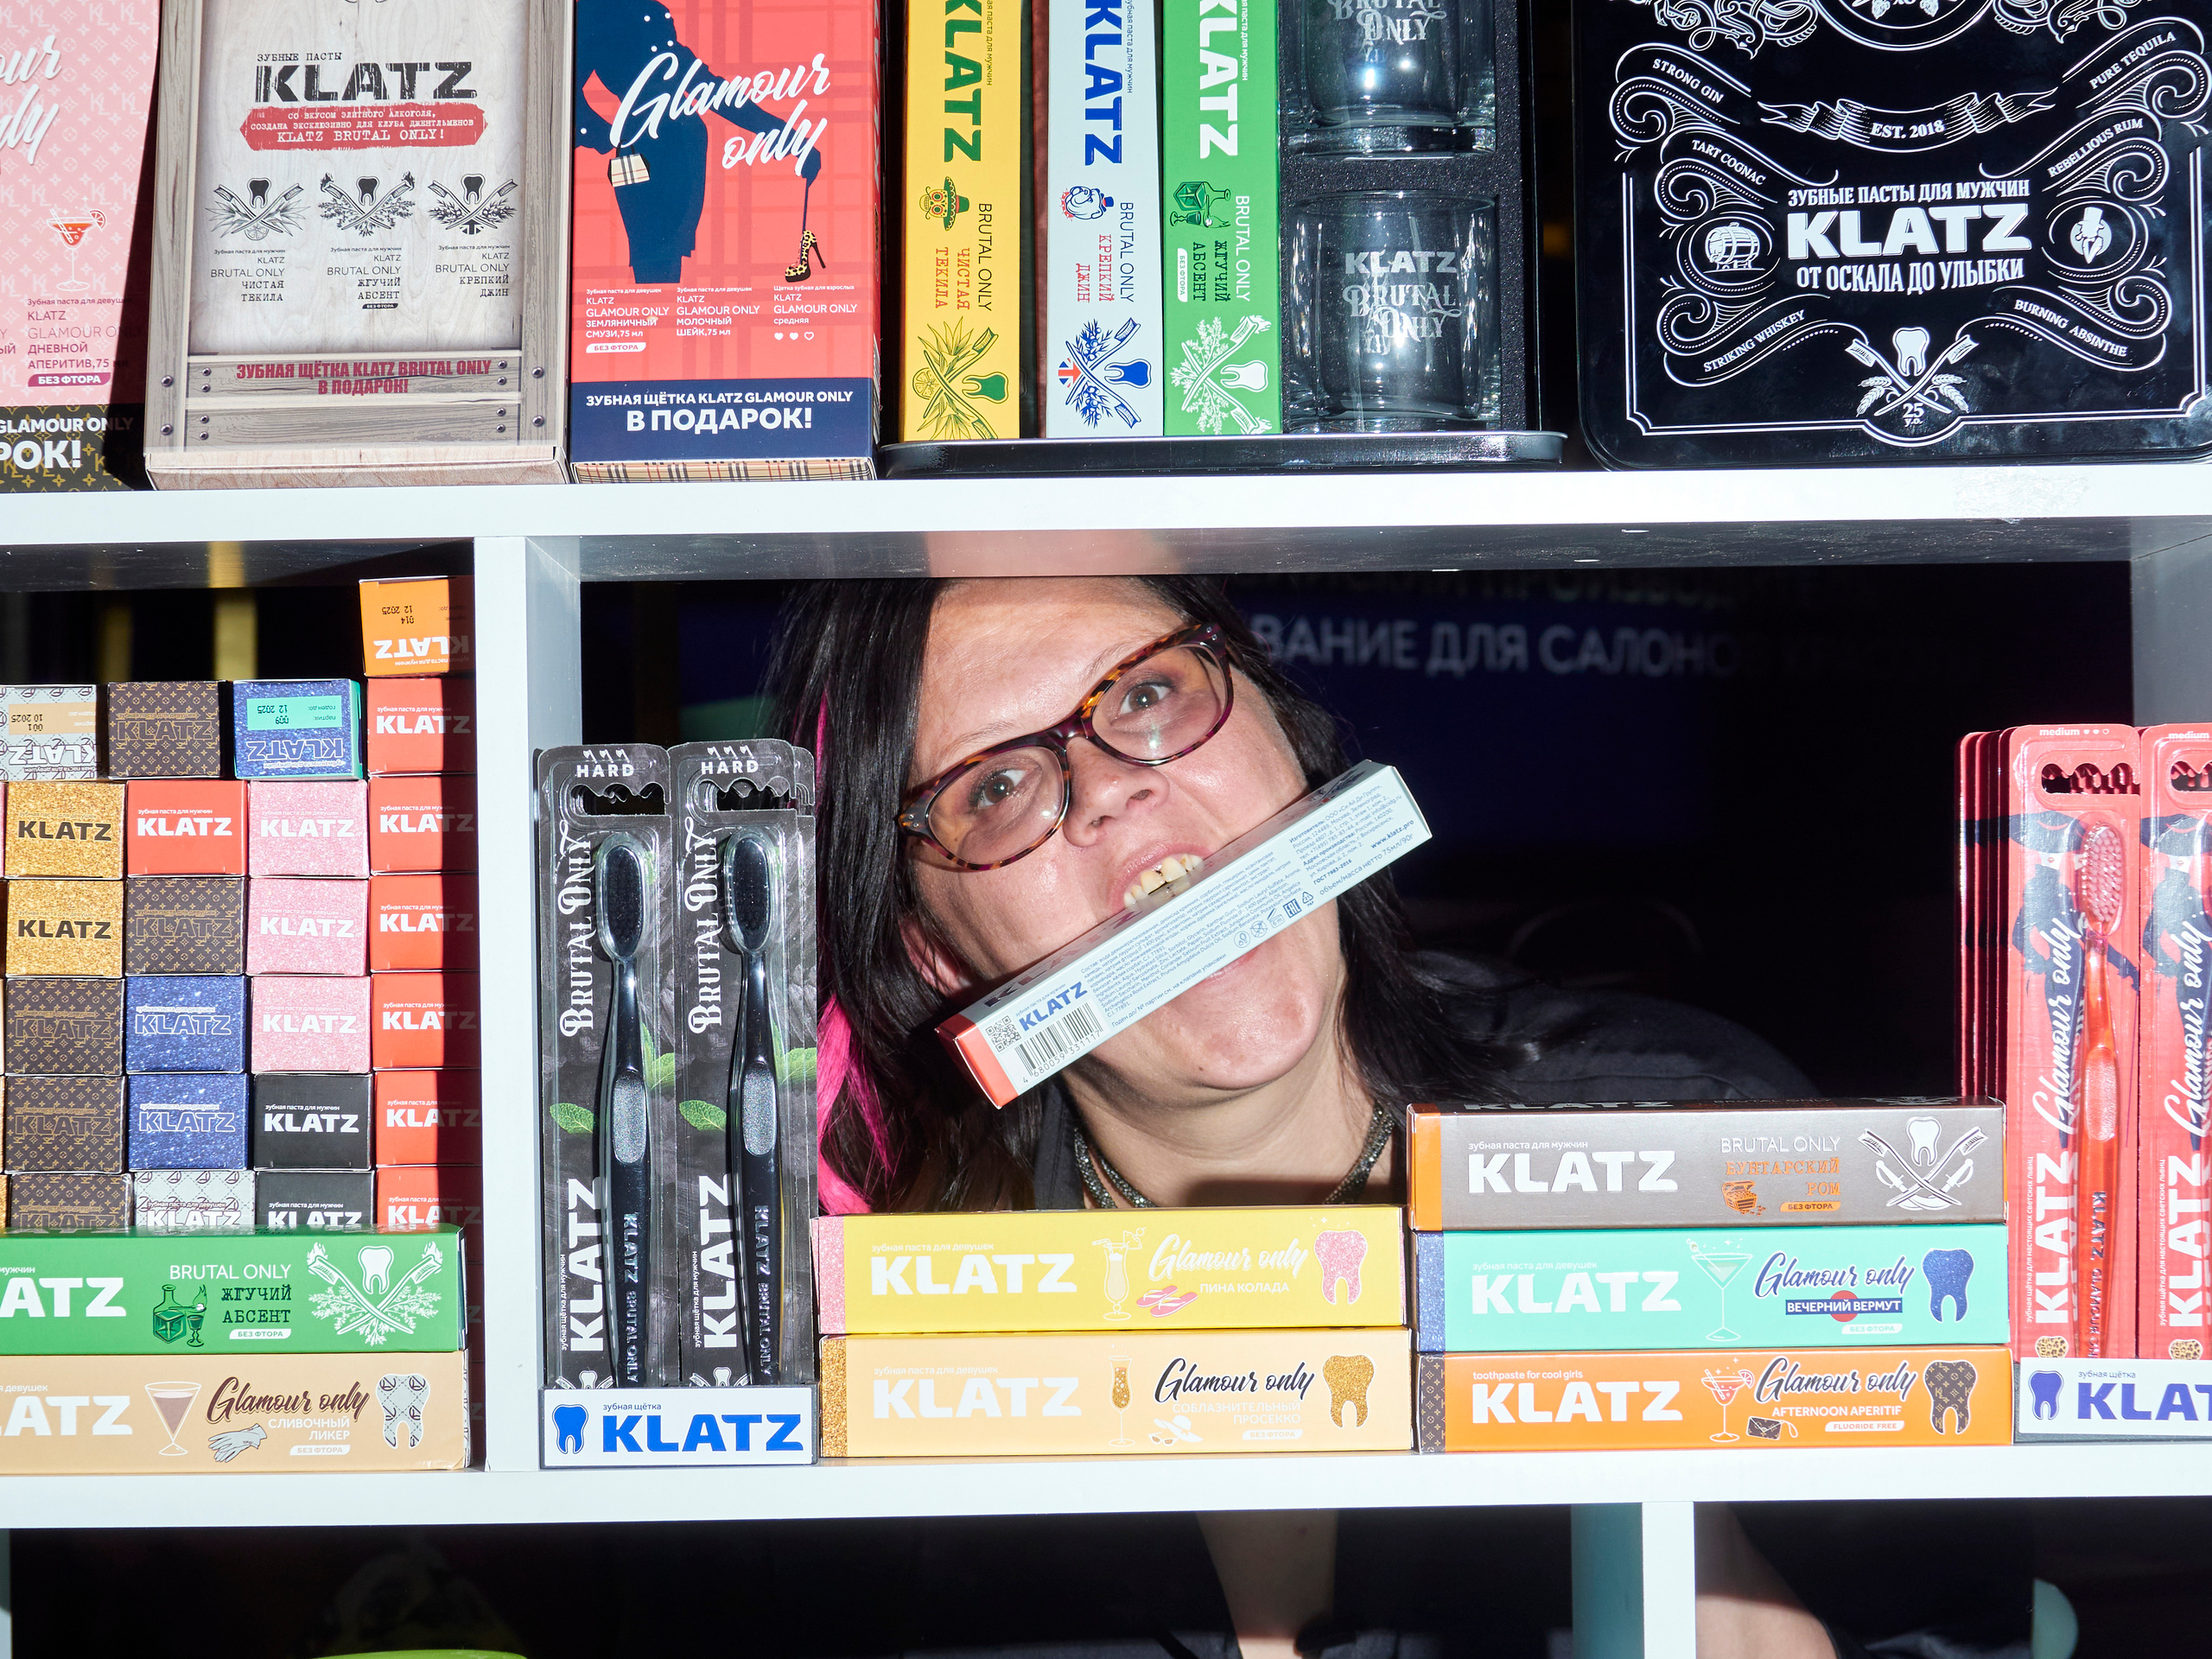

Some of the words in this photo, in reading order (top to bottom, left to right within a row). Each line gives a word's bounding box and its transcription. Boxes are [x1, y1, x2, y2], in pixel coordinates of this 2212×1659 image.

[257, 53, 300, 62] ЗУБНЫЕ
[306, 52, 342, 61] ПАСТЫ
[2088, 62, 2123, 90] PURE
[2120, 31, 2177, 67] TEQUILA
[255, 62, 478, 102] KLATZ
[1085, 0, 1122, 166] KLATZ
[1652, 58, 1700, 90] STRONG
[1700, 85, 1725, 104] GIN
[609, 52, 831, 149] Glamour
[341, 111, 385, 119] ЭЛИТНОГО
[389, 110, 436, 119] АЛКОГОЛЯ,
[276, 131, 324, 143] KLATZ
[334, 130, 391, 142] BRUTAL
[400, 129, 445, 141] ONLY!
[721, 99, 828, 177] only
[1871, 123, 1907, 139] EST.
[1909, 119, 1945, 138] 2018
[2047, 130, 2115, 178] REBELLIOUS
[2113, 118, 2144, 135] RUM
[1691, 139, 1723, 161] TART
[1719, 153, 1766, 187] COGNAC
[1788, 187, 1854, 207] ЗУБНЫЕ
[1858, 184, 1916, 205] ПАСТЫ
[1918, 182, 1952, 203] ДЛЯ
[1955, 179, 2031, 200] МУЖЧИН
[978, 203, 992, 264] BRUTAL
[1235, 195, 1249, 256] BRUTAL
[1787, 203, 2032, 260] KLATZ
[1099, 234, 1115, 302] КРЕПКИЙ
[1193, 242, 1206, 301] АБСЕНТ
[1215, 240, 1230, 302] ЖГУЧИЙ
[1345, 251, 1458, 275] KLATZ
[242, 280, 285, 289] ЧИСТАЯ
[357, 276, 401, 287] ЖГУЧИЙ
[459, 273, 510, 285] КРЕПКИЙ
[936, 247, 948, 308] ТЕКИЛА
[957, 247, 969, 309] ЧИСТАЯ
[1076, 264, 1090, 303] ДЖИН
[1236, 260, 1250, 302] ONLY
[1796, 265, 1822, 289] ОТ
[1825, 263, 1905, 295] ОСКАЛА
[1907, 262, 1936, 296] ДО
[1940, 258, 2024, 291] УЛЫБКИ
[241, 293, 284, 302] ТЕКИЛА
[358, 289, 401, 300] АБСЕНТ
[480, 288, 510, 298] ДЖИН
[978, 268, 992, 311] ONLY
[1342, 283, 1457, 317] BRUTAL
[28, 310, 67, 321] KLATZ
[586, 307, 639, 317] GLAMOUR
[641, 306, 670, 316] ONLY
[586, 316, 658, 327] ЗЕМЛЯНИЧНЫЙ
[677, 316, 732, 326] МОЛОЧНЫЙ
[773, 317, 809, 326] средняя
[28, 326, 103, 340] GLAMOUR
[677, 327, 717, 337] ШЕЙК,75
[1375, 304, 1463, 342] ONLY
[2013, 299, 2069, 329] BURNING
[2069, 325, 2128, 357] ABSINTHE
[586, 329, 630, 339] СМУЗИ,75
[1703, 338, 1756, 373] STRIKING
[1753, 309, 1806, 343] WHISKEY
[27, 341, 88, 355] ДНЕВНОЙ
[28, 359, 110, 370] АПЕРИТИВ,75
[237, 363, 295, 379] ЗУБНАЯ
[298, 360, 350, 379] ЩЁТКА
[353, 362, 396, 378] KLATZ
[397, 361, 454, 377] BRUTAL
[456, 360, 493, 376] ONLY
[38, 376, 60, 385] БЕЗ
[61, 375, 101, 385] ФТОРА
[318, 380, 327, 396] В
[332, 378, 410, 397] ПОДАРОК!
[586, 394, 642, 406] ЗУБНАЯ
[644, 391, 696, 407] ЩЁТКА
[698, 392, 743, 404] KLATZ
[745, 391, 815, 404] GLAMOUR
[817, 391, 854, 403] ONLY
[1902, 403, 1925, 418] 25
[86, 417, 134, 431] ONLY
[626, 410, 645, 432] В
[651, 408, 813, 435] ПОДАРОК!
[373, 635, 469, 659] KLATZ
[1427, 622, 1528, 677] ДЛЯ
[1538, 622, 1763, 679] САЛОНО
[11, 714, 32, 723] 2025
[34, 714, 43, 722] 10
[377, 715, 471, 734] KLATZ
[2039, 728, 2081, 736] medium
[246, 738, 344, 761] KLATZ
[576, 764, 635, 778] HARD
[18, 820, 112, 841] KLATZ
[137, 817, 232, 836] KLATZ
[260, 818, 354, 838] KLATZ
[1370, 819, 1414, 849] www.klatz.pro
[557, 820, 593, 915] ONLY
[2040, 918, 2082, 985] only
[559, 916, 596, 1037] BRUTAL
[1019, 981, 1088, 1032] KLATZ
[135, 1014, 232, 1035] KLATZ
[2033, 995, 2075, 1135] Glamour
[264, 1113, 359, 1134] KLATZ
[1720, 1138, 1789, 1154] BRUTAL
[1794, 1136, 1840, 1153] ONLY
[1468, 1151, 1679, 1193] KLATZ
[1725, 1157, 1840, 1177] БУНТАРСКИЙ
[1806, 1181, 1840, 1198] РОМ
[2036, 1151, 2070, 1325] KLATZ
[169, 1264, 240, 1281] BRUTAL
[244, 1263, 292, 1280] ONLY
[568, 1178, 604, 1351] KLATZ
[871, 1253, 1077, 1296] KLATZ
[1755, 1253, 1857, 1297] Glamour
[1865, 1255, 1915, 1294] only
[221, 1283, 292, 1302] ЖГУЧИЙ
[1199, 1282, 1234, 1294] ПИНА
[1236, 1281, 1290, 1294] КОЛАДА
[1472, 1271, 1682, 1314] KLATZ
[222, 1309, 291, 1324] АБСЕНТ
[1787, 1299, 1851, 1313] ВЕЧЕРНИЙ
[1853, 1299, 1901, 1313] ВЕРМУТ
[1154, 1357, 1260, 1403] Glamour
[1266, 1361, 1315, 1401] only
[1473, 1370, 1524, 1381] toothpaste
[1526, 1370, 1539, 1379] for
[1541, 1370, 1560, 1379] cool
[1562, 1370, 1583, 1381] girls
[1756, 1357, 1860, 1403] Glamour
[1867, 1361, 1916, 1401] only
[207, 1376, 314, 1425] Glamour
[319, 1381, 370, 1421] only
[603, 1403, 632, 1412] зубная
[634, 1402, 662, 1412] щётка
[873, 1376, 1082, 1419] KLATZ
[1173, 1399, 1300, 1414] СОБЛАЗНИТЕЛЬНЫЙ
[1473, 1381, 1683, 1423] KLATZ
[269, 1414, 350, 1429] СЛИВОЧНЫЙ
[1233, 1414, 1301, 1424] ПРОСЕККО
[1772, 1407, 1848, 1417] AFTERNOON
[1850, 1406, 1902, 1416] APERITIF
[308, 1430, 350, 1440] ЛИКЕР
[602, 1414, 804, 1452] KLATZ
